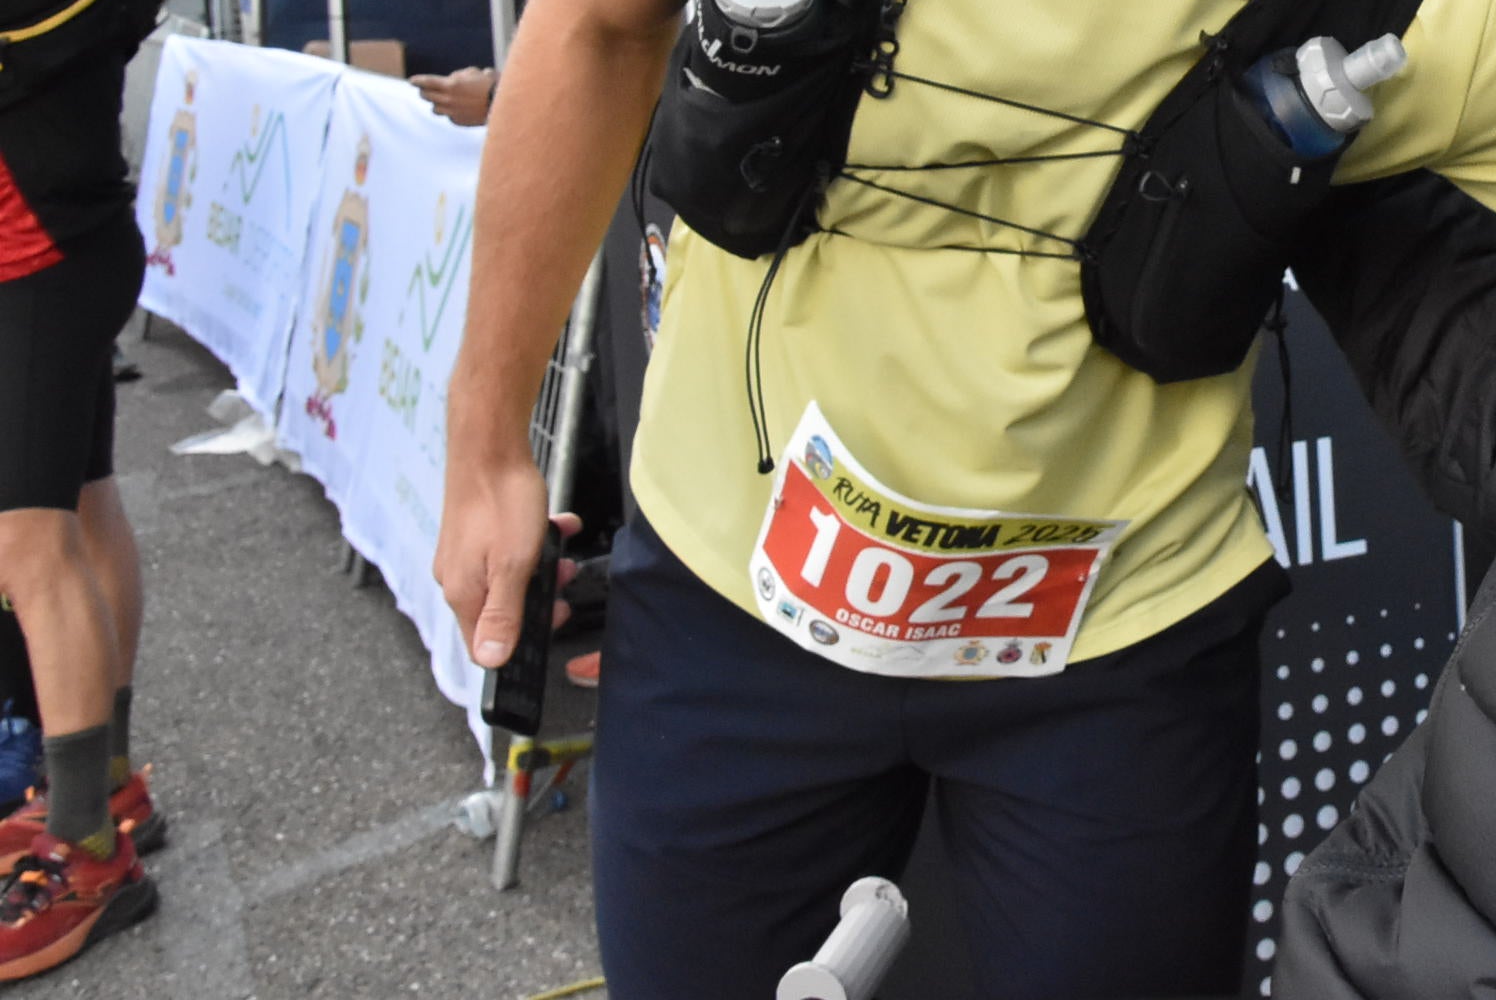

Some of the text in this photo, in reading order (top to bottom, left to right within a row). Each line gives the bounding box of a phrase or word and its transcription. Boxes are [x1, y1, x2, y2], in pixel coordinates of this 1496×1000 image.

[832, 476, 881, 529] RUTA
[799, 505, 1049, 625] 1022
[835, 607, 899, 639] OSCAR
[904, 623, 962, 640] ISAAC
